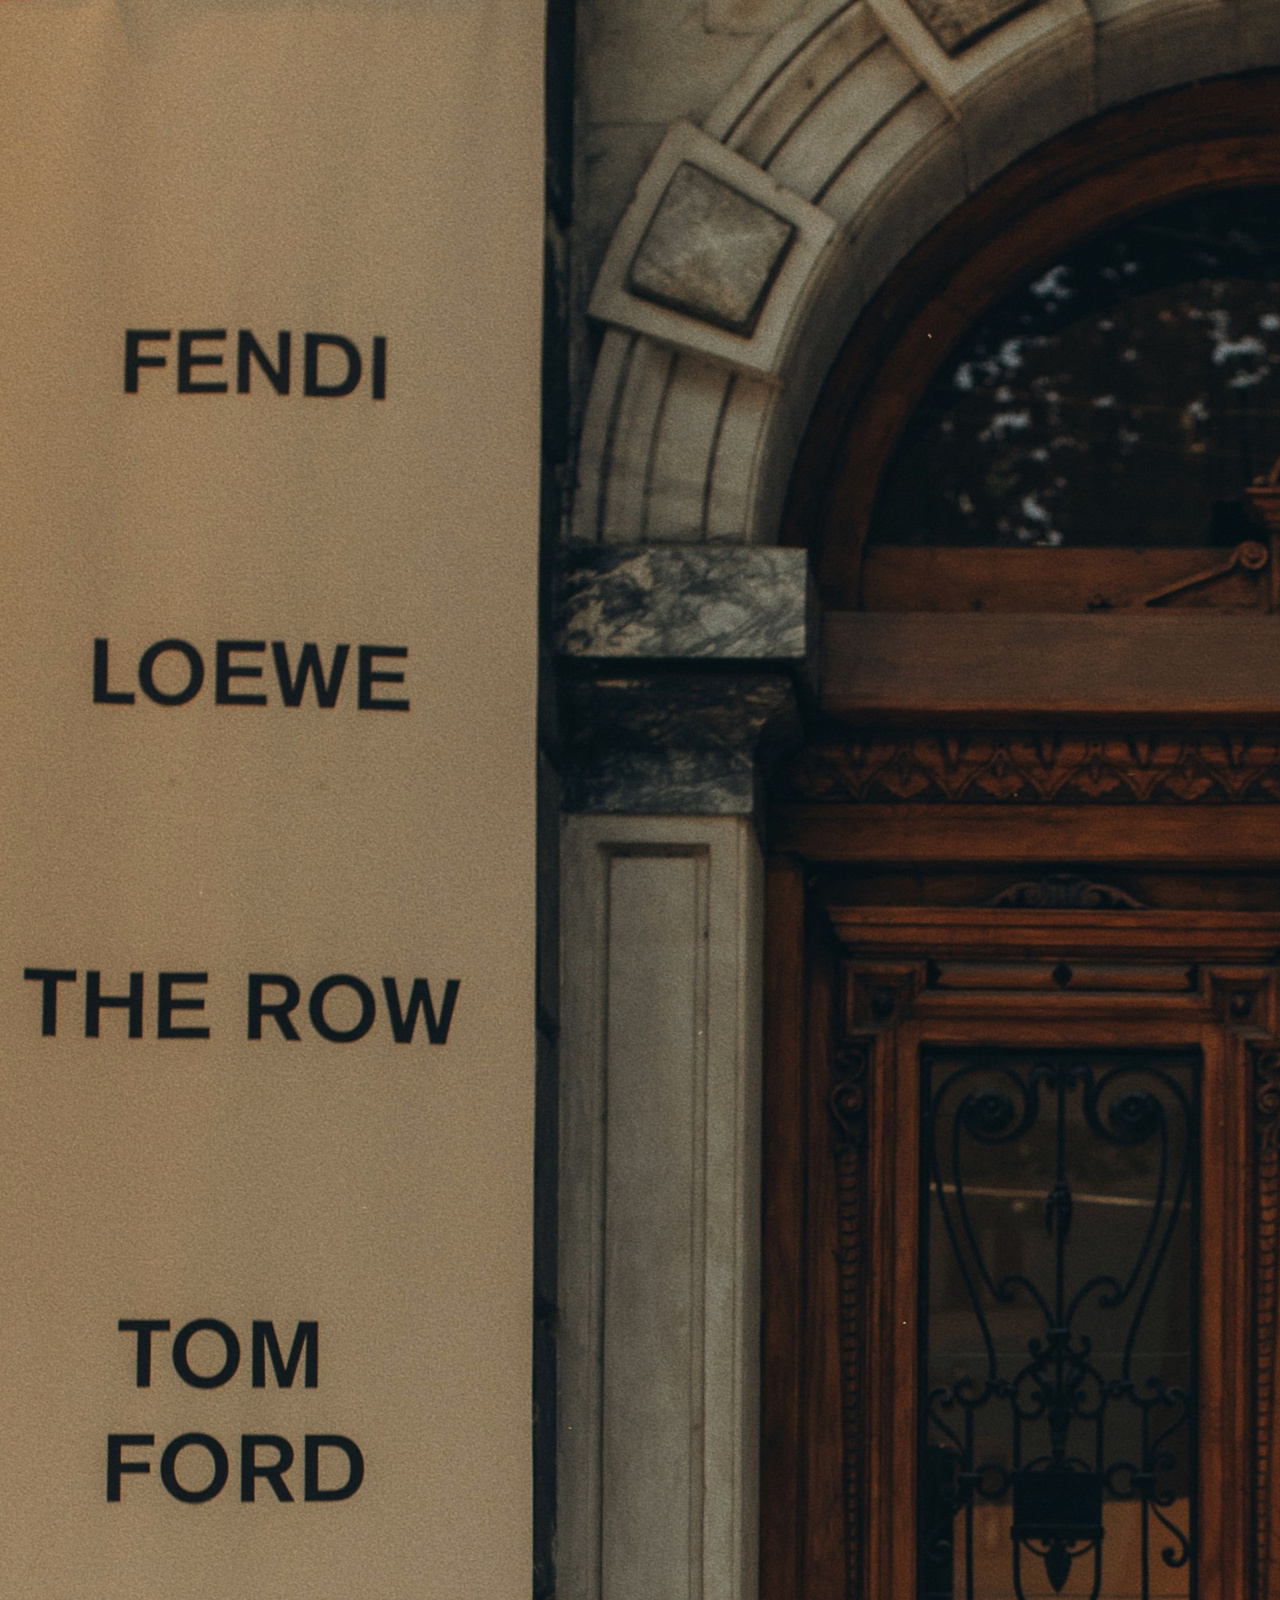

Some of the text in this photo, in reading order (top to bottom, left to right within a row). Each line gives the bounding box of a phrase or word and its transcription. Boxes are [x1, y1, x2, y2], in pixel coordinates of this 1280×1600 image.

[123, 328, 387, 399] FENDI
[92, 637, 410, 713] LOEWE
[23, 967, 462, 1046] THE ROW
[117, 1317, 319, 1389] TOM
[106, 1431, 365, 1505] FORD
